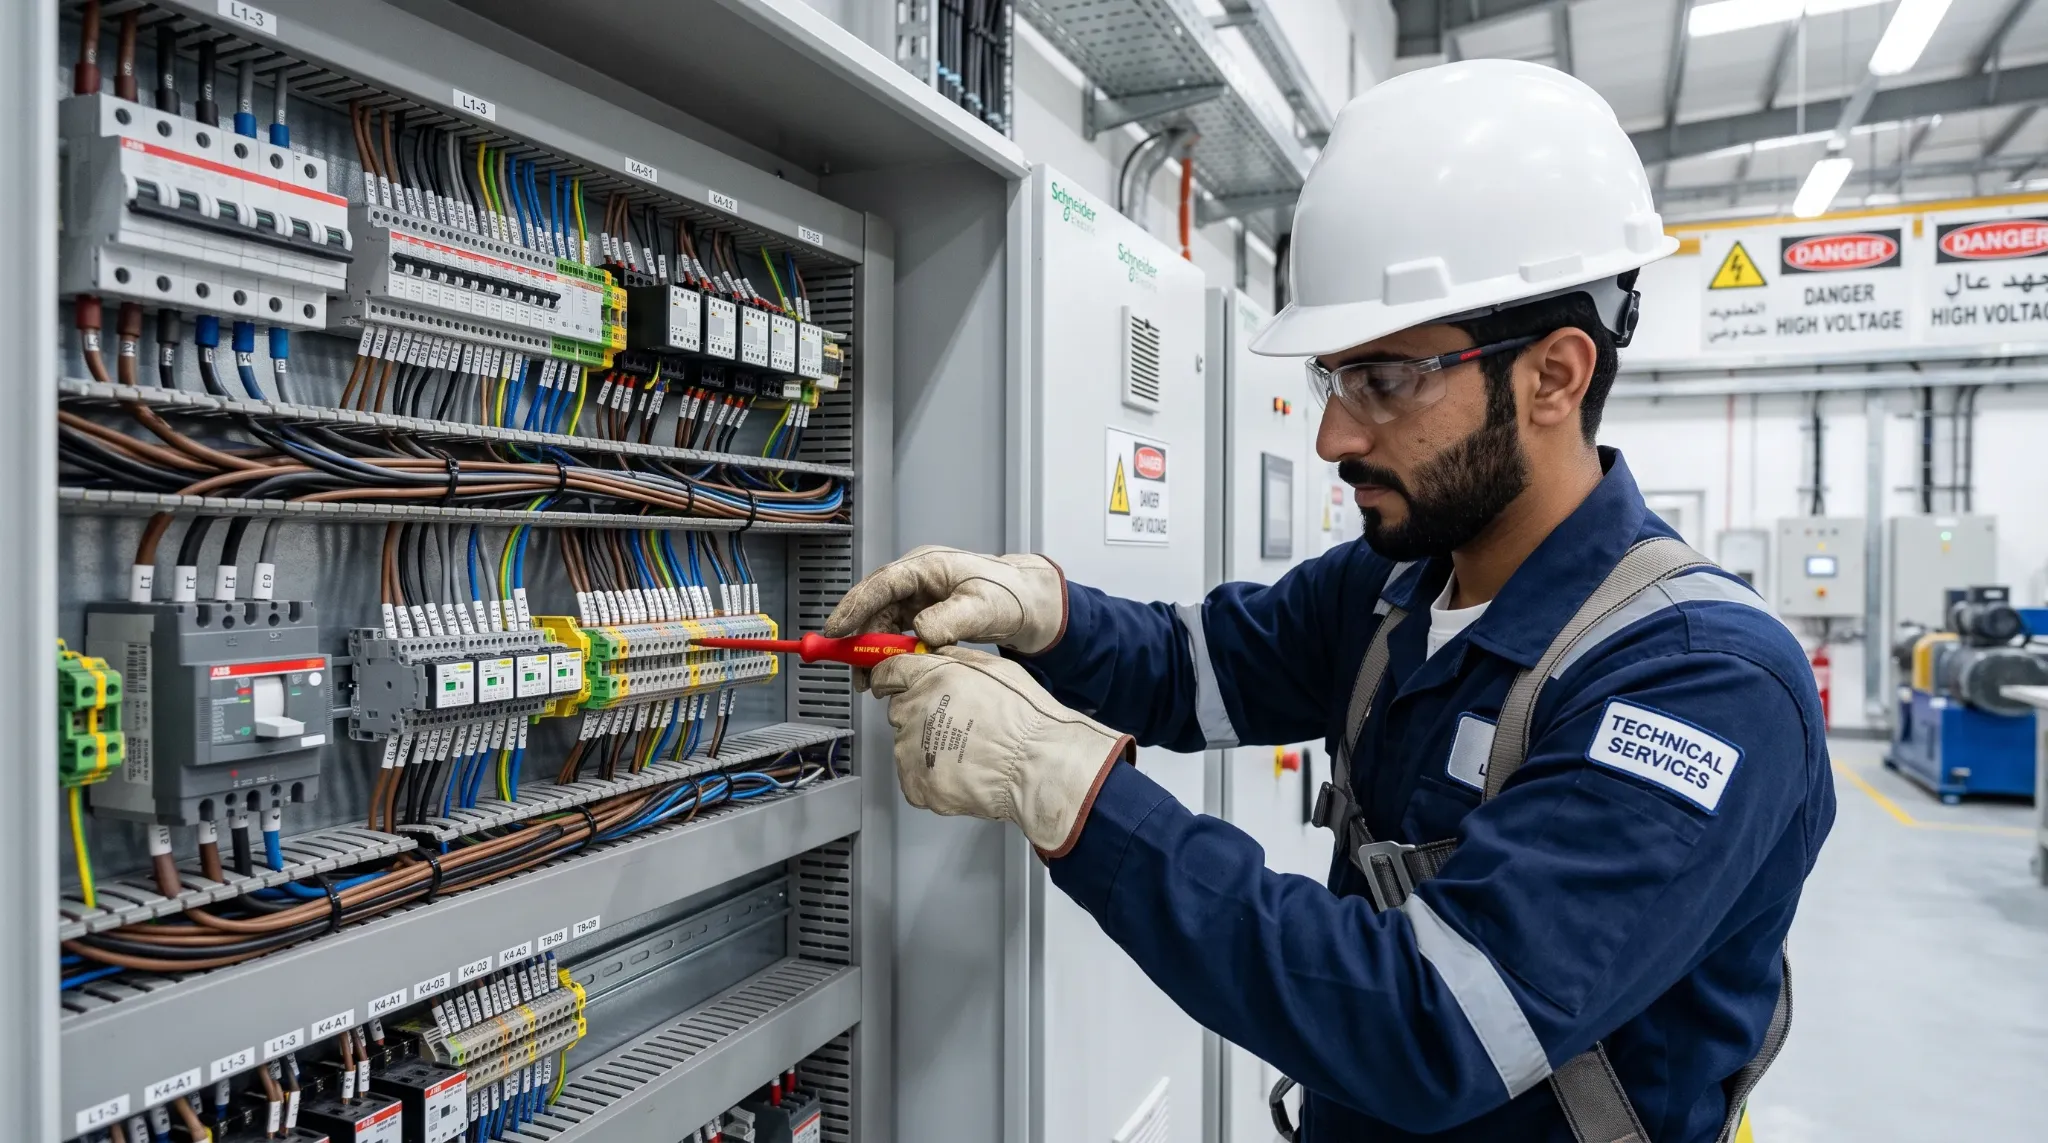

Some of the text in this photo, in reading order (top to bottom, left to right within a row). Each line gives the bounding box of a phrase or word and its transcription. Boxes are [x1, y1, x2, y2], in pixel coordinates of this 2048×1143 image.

[231, 2, 264, 27] L1-3
[463, 95, 487, 115] L1-3
[1051, 181, 1096, 223] Schneider
[1952, 226, 2048, 253] DANGER
[1117, 242, 1158, 279] Schneider
[1795, 240, 1885, 265] DANGER
[1804, 283, 1875, 306] DANGER
[1776, 315, 1818, 336] HIGH
[1823, 310, 1903, 333] VOLTAGE
[1931, 305, 1977, 326] HIGH
[1140, 489, 1160, 509] DANGER
[1146, 517, 1167, 536] VOLTAGE
[1612, 714, 1723, 776] TECHNICAL
[1608, 736, 1710, 790] SERVICES
[374, 994, 400, 1012] K4-A1
[318, 1015, 347, 1036] K4-A1
[272, 1034, 296, 1052] L1-3
[220, 1054, 246, 1073] L1-3
[154, 1076, 191, 1098] K4-A1
[88, 1103, 119, 1124] L1-3
